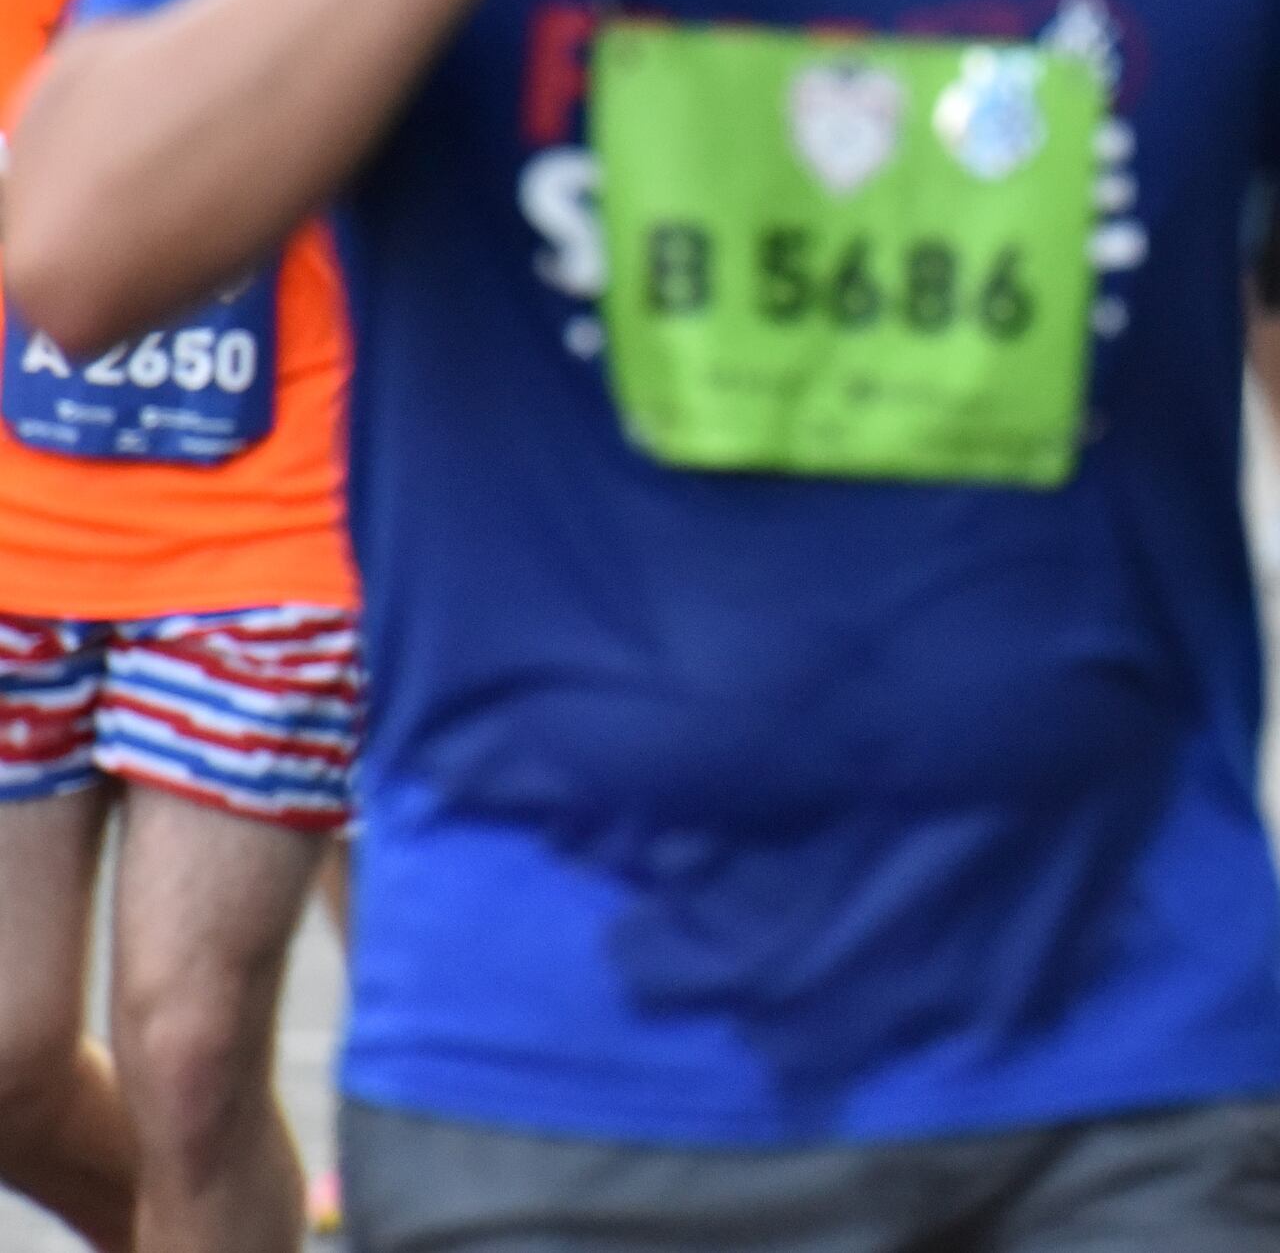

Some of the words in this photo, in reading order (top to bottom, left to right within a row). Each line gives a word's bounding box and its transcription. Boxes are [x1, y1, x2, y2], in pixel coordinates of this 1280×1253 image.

[753, 227, 1036, 344] 5686
[20, 329, 71, 379] A
[83, 326, 258, 393] 2650
